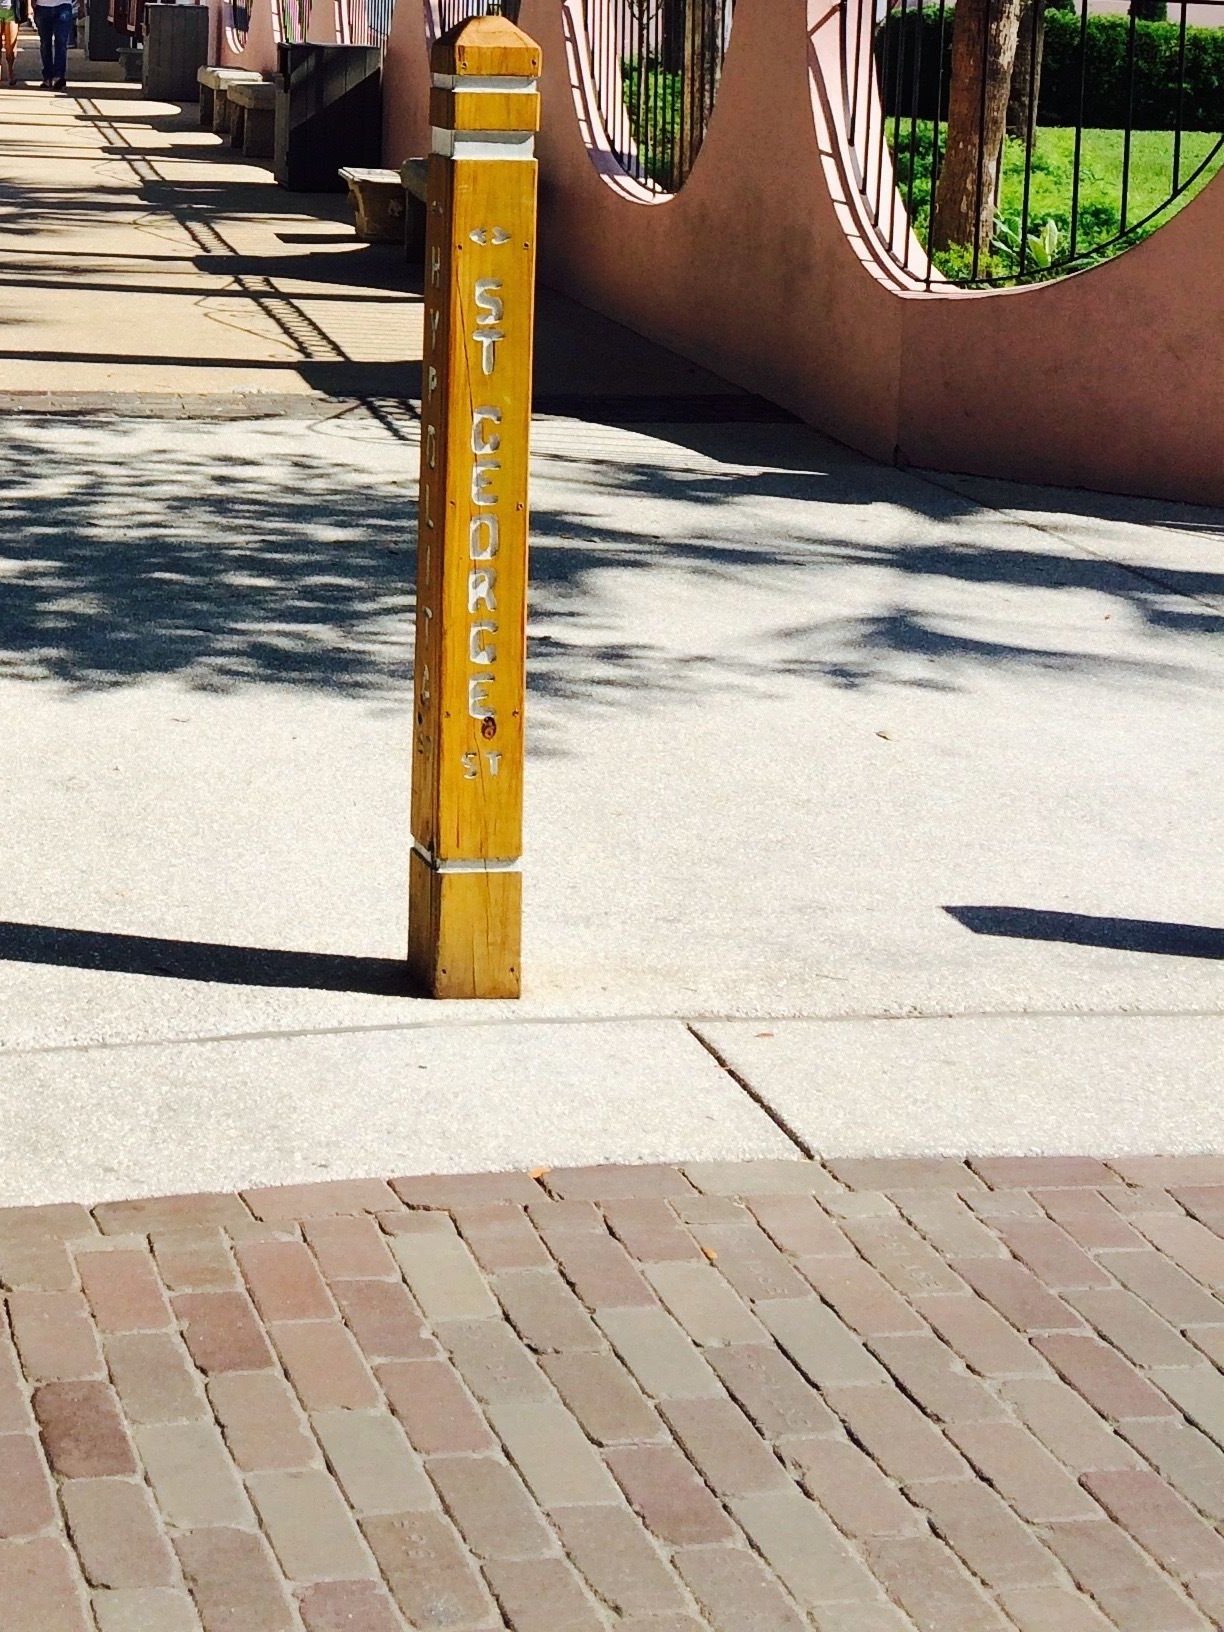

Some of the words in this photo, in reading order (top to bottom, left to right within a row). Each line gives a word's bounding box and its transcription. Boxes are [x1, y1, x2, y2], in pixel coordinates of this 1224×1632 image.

[472, 278, 506, 375] ST
[467, 406, 502, 719] GEORGE
[462, 751, 503, 780] ST
